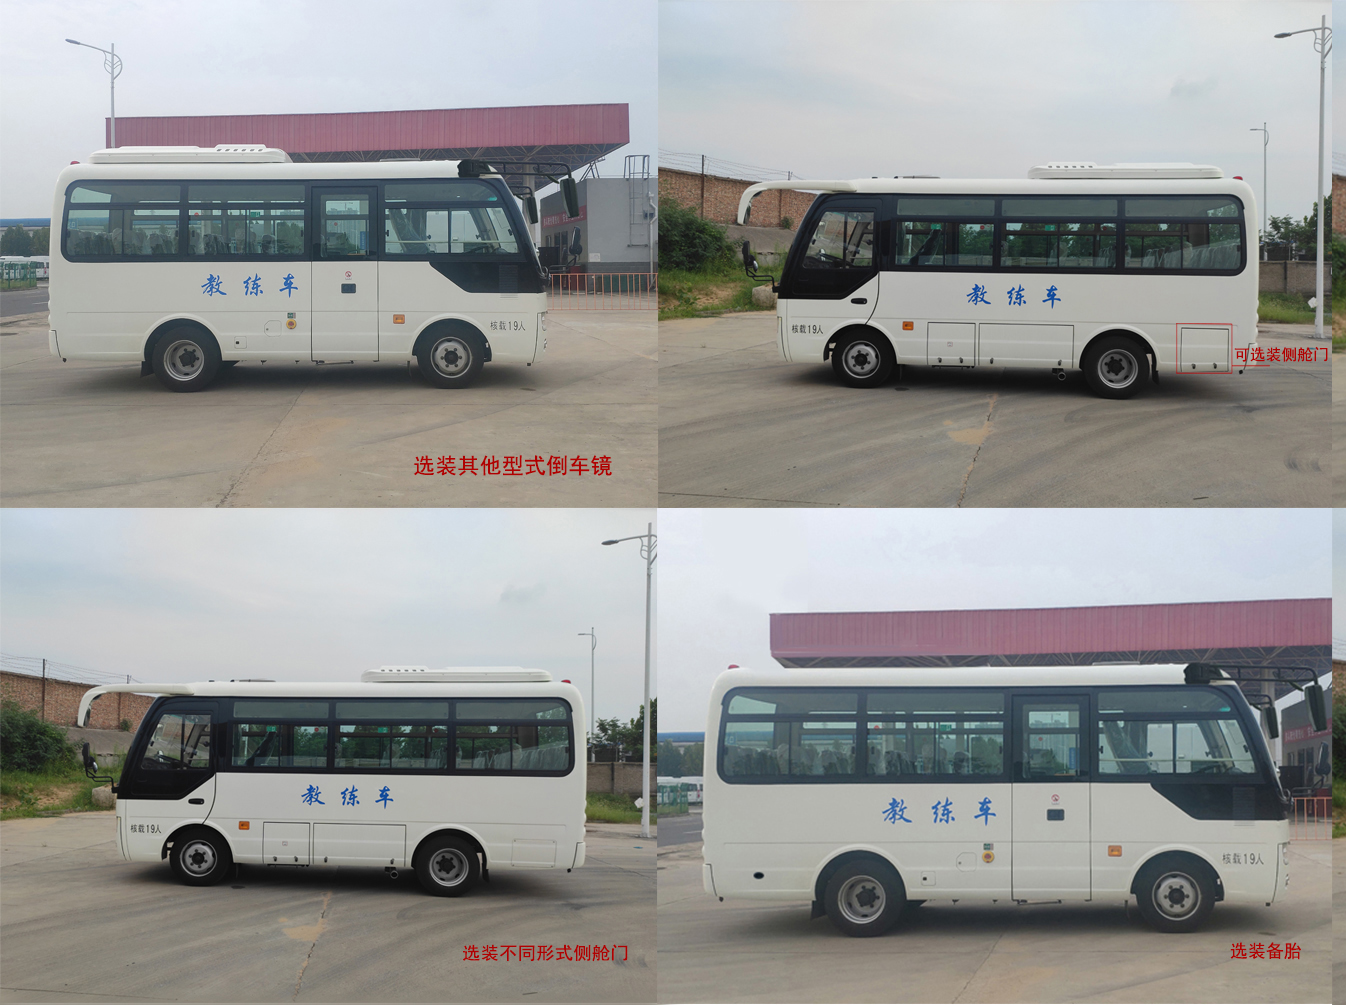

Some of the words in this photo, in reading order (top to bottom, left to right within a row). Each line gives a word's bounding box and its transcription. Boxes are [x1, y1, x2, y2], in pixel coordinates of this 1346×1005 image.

[201, 274, 299, 298] 教练车
[966, 284, 1062, 309] 教练车
[489, 320, 526, 332] 核载19人
[791, 324, 824, 334] 核载19人
[301, 785, 394, 809] 教练车
[882, 797, 997, 826] 教练车
[130, 824, 162, 834] 核载19人
[1222, 852, 1264, 865] 核载19人
